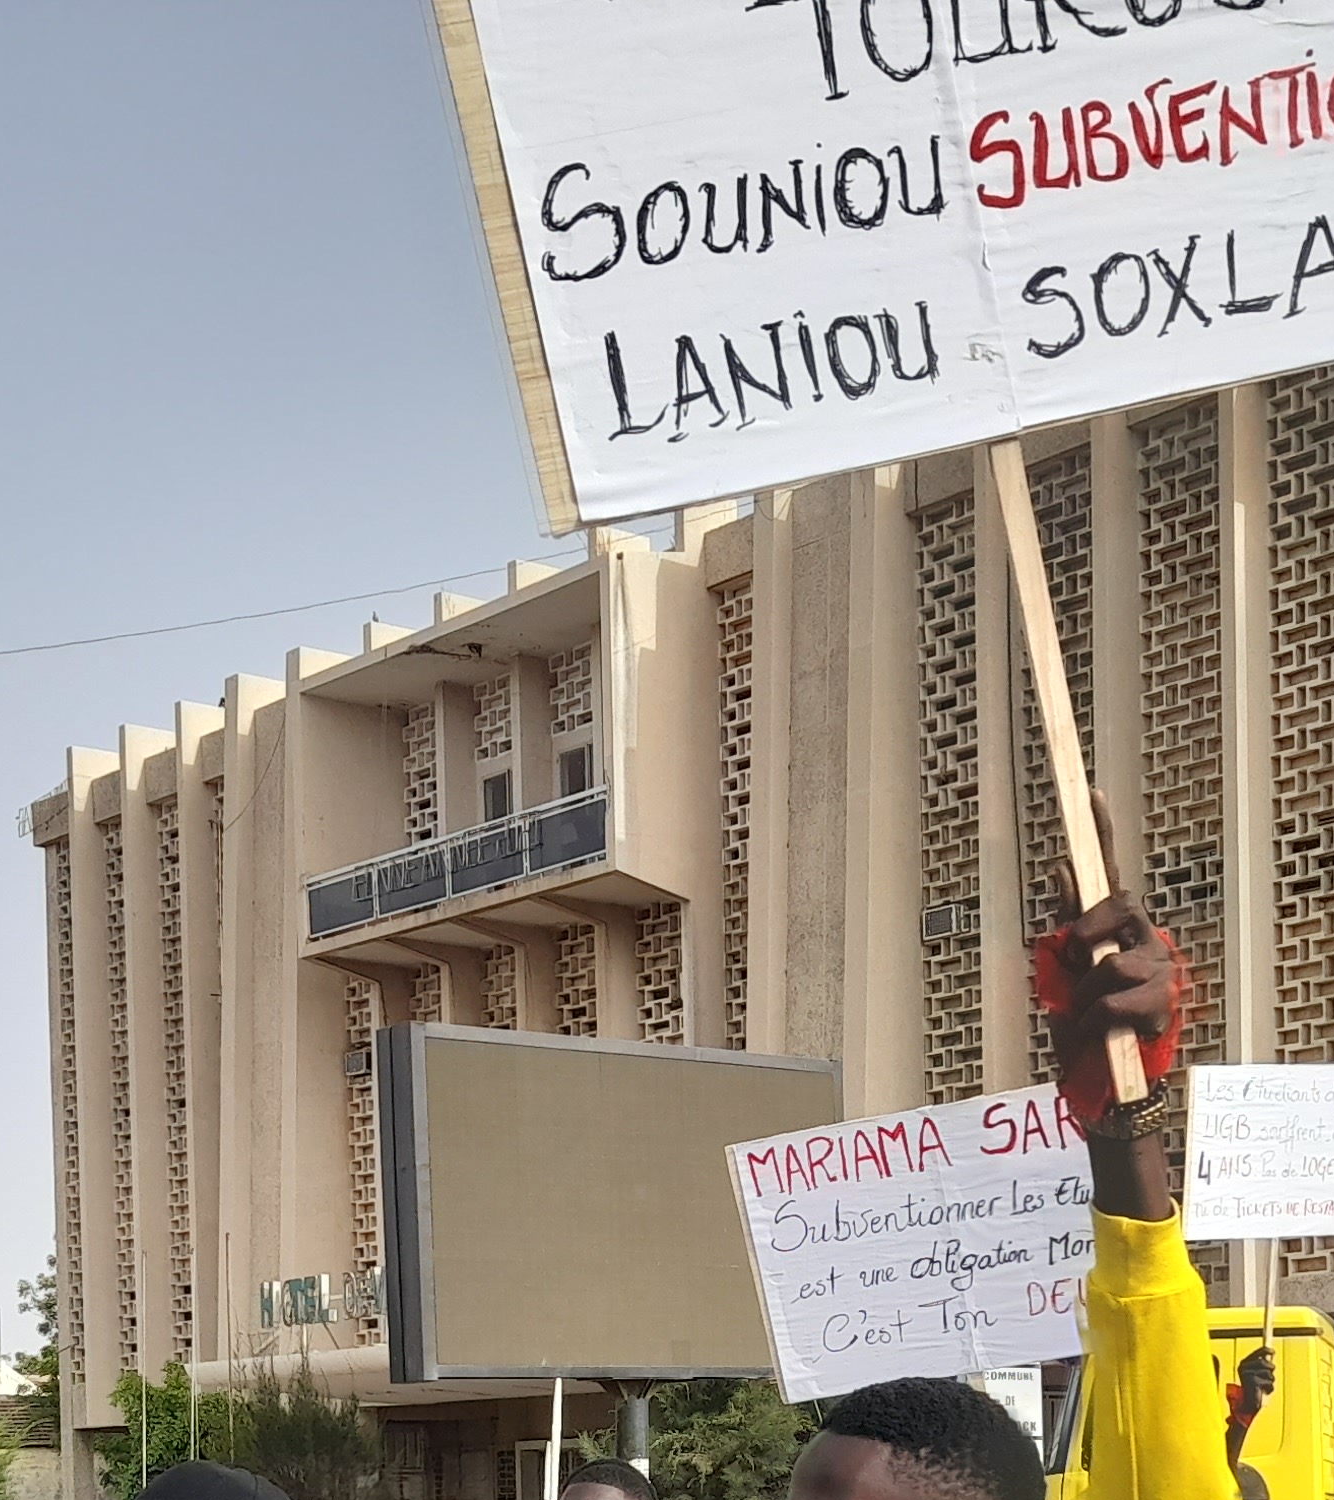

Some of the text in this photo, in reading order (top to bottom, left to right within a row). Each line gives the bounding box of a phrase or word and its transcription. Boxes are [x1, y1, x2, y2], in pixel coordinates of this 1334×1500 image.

[747, 1117, 953, 1197] MARIAMA
[1197, 1151, 1211, 1185] 4
[771, 1193, 1002, 1252] Subventionner
[791, 1266, 844, 1304] est
[859, 1265, 899, 1288] une
[911, 1239, 1033, 1291] obligation
[823, 1309, 914, 1352] C'est
[918, 1295, 998, 1334] Ton
